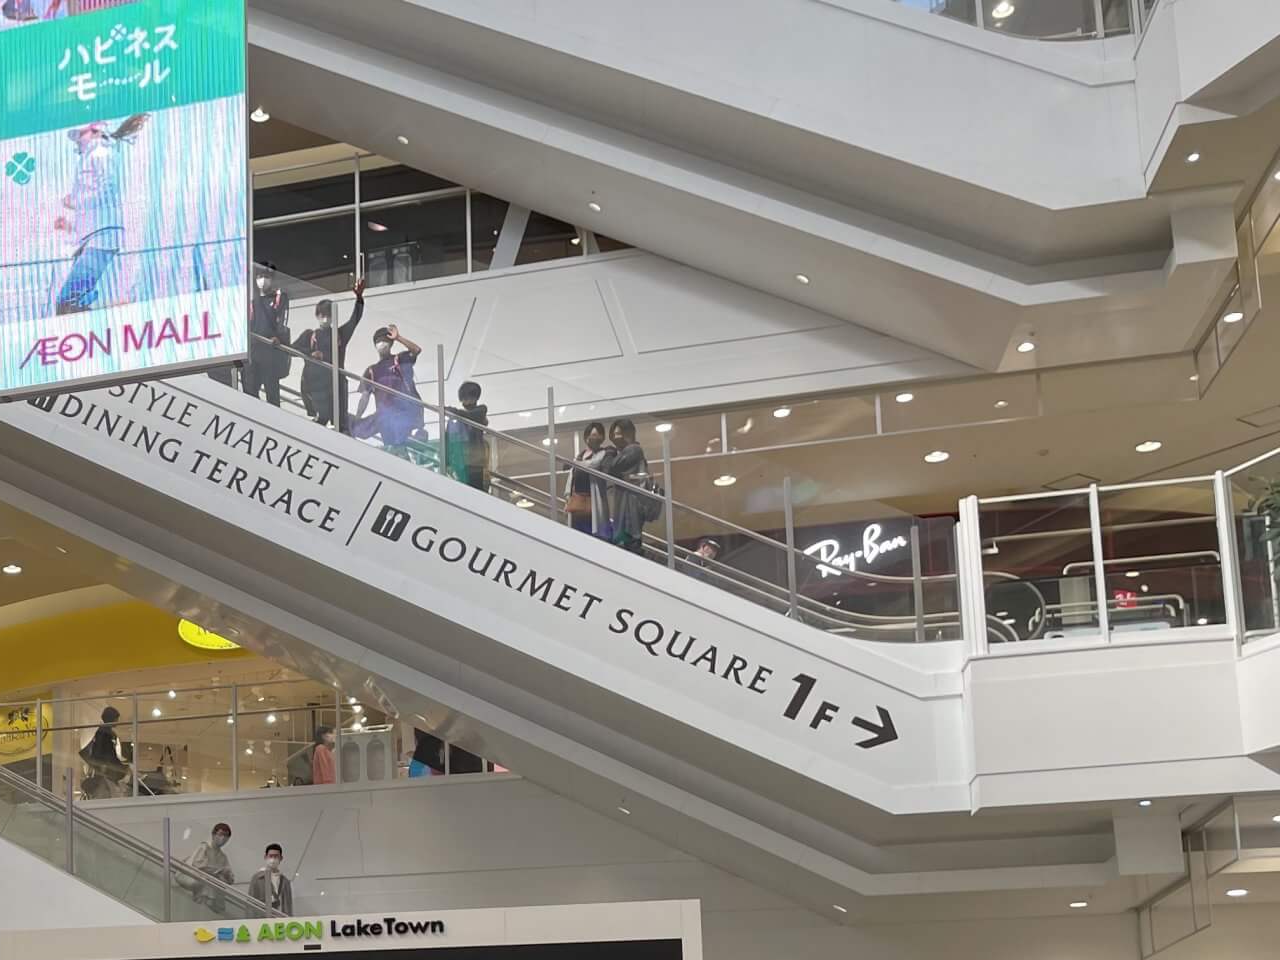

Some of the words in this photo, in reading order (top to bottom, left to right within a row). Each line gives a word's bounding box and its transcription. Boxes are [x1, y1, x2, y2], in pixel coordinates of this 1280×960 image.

[58, 24, 179, 71] ハピネス
[123, 311, 221, 353] MALL
[59, 394, 182, 463] DINING
[189, 449, 341, 532] TERRACE
[201, 414, 339, 486] MARKET
[411, 525, 603, 621] GOURMET
[608, 607, 774, 695] SQUARE
[257, 920, 323, 942] AEON
